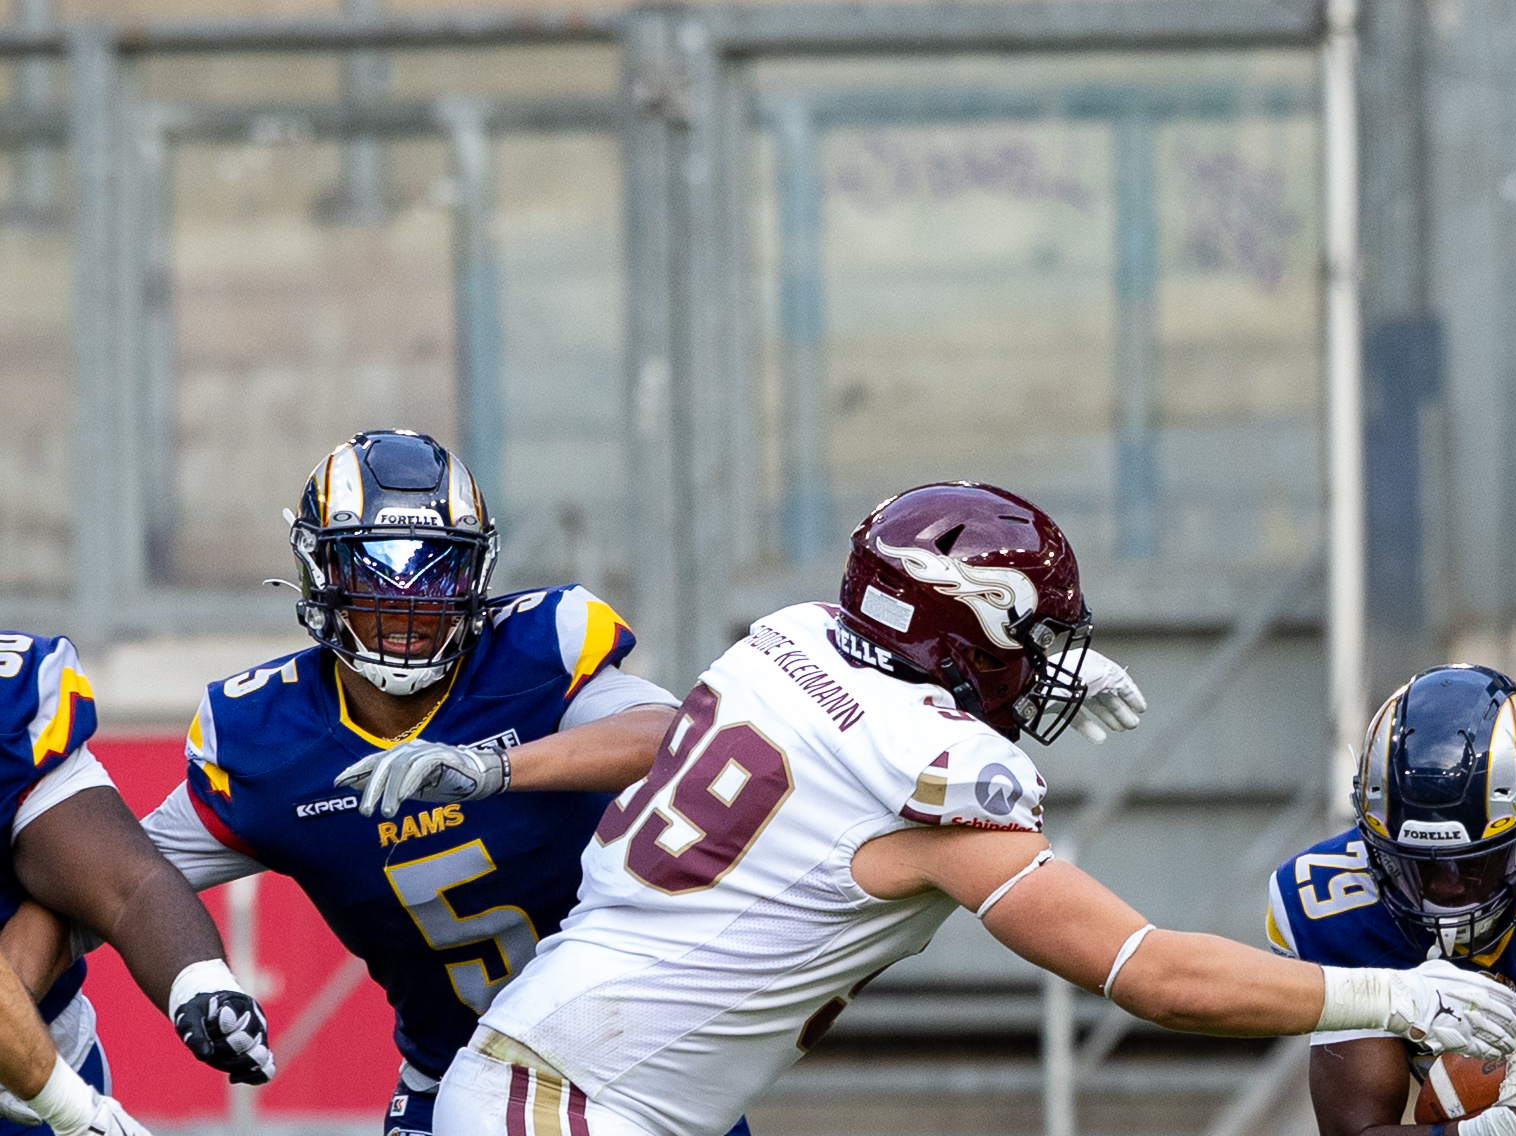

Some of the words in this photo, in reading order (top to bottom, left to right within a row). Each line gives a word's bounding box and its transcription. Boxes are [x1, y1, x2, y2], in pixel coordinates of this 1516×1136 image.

[380, 514, 438, 526] FORELLE
[773, 650, 865, 732] KLEIMANN
[377, 803, 465, 848] RAMS
[594, 680, 795, 896] 99
[1403, 829, 1461, 841] FORELLE
[1295, 840, 1380, 920] 29
[384, 838, 540, 1015] 5
